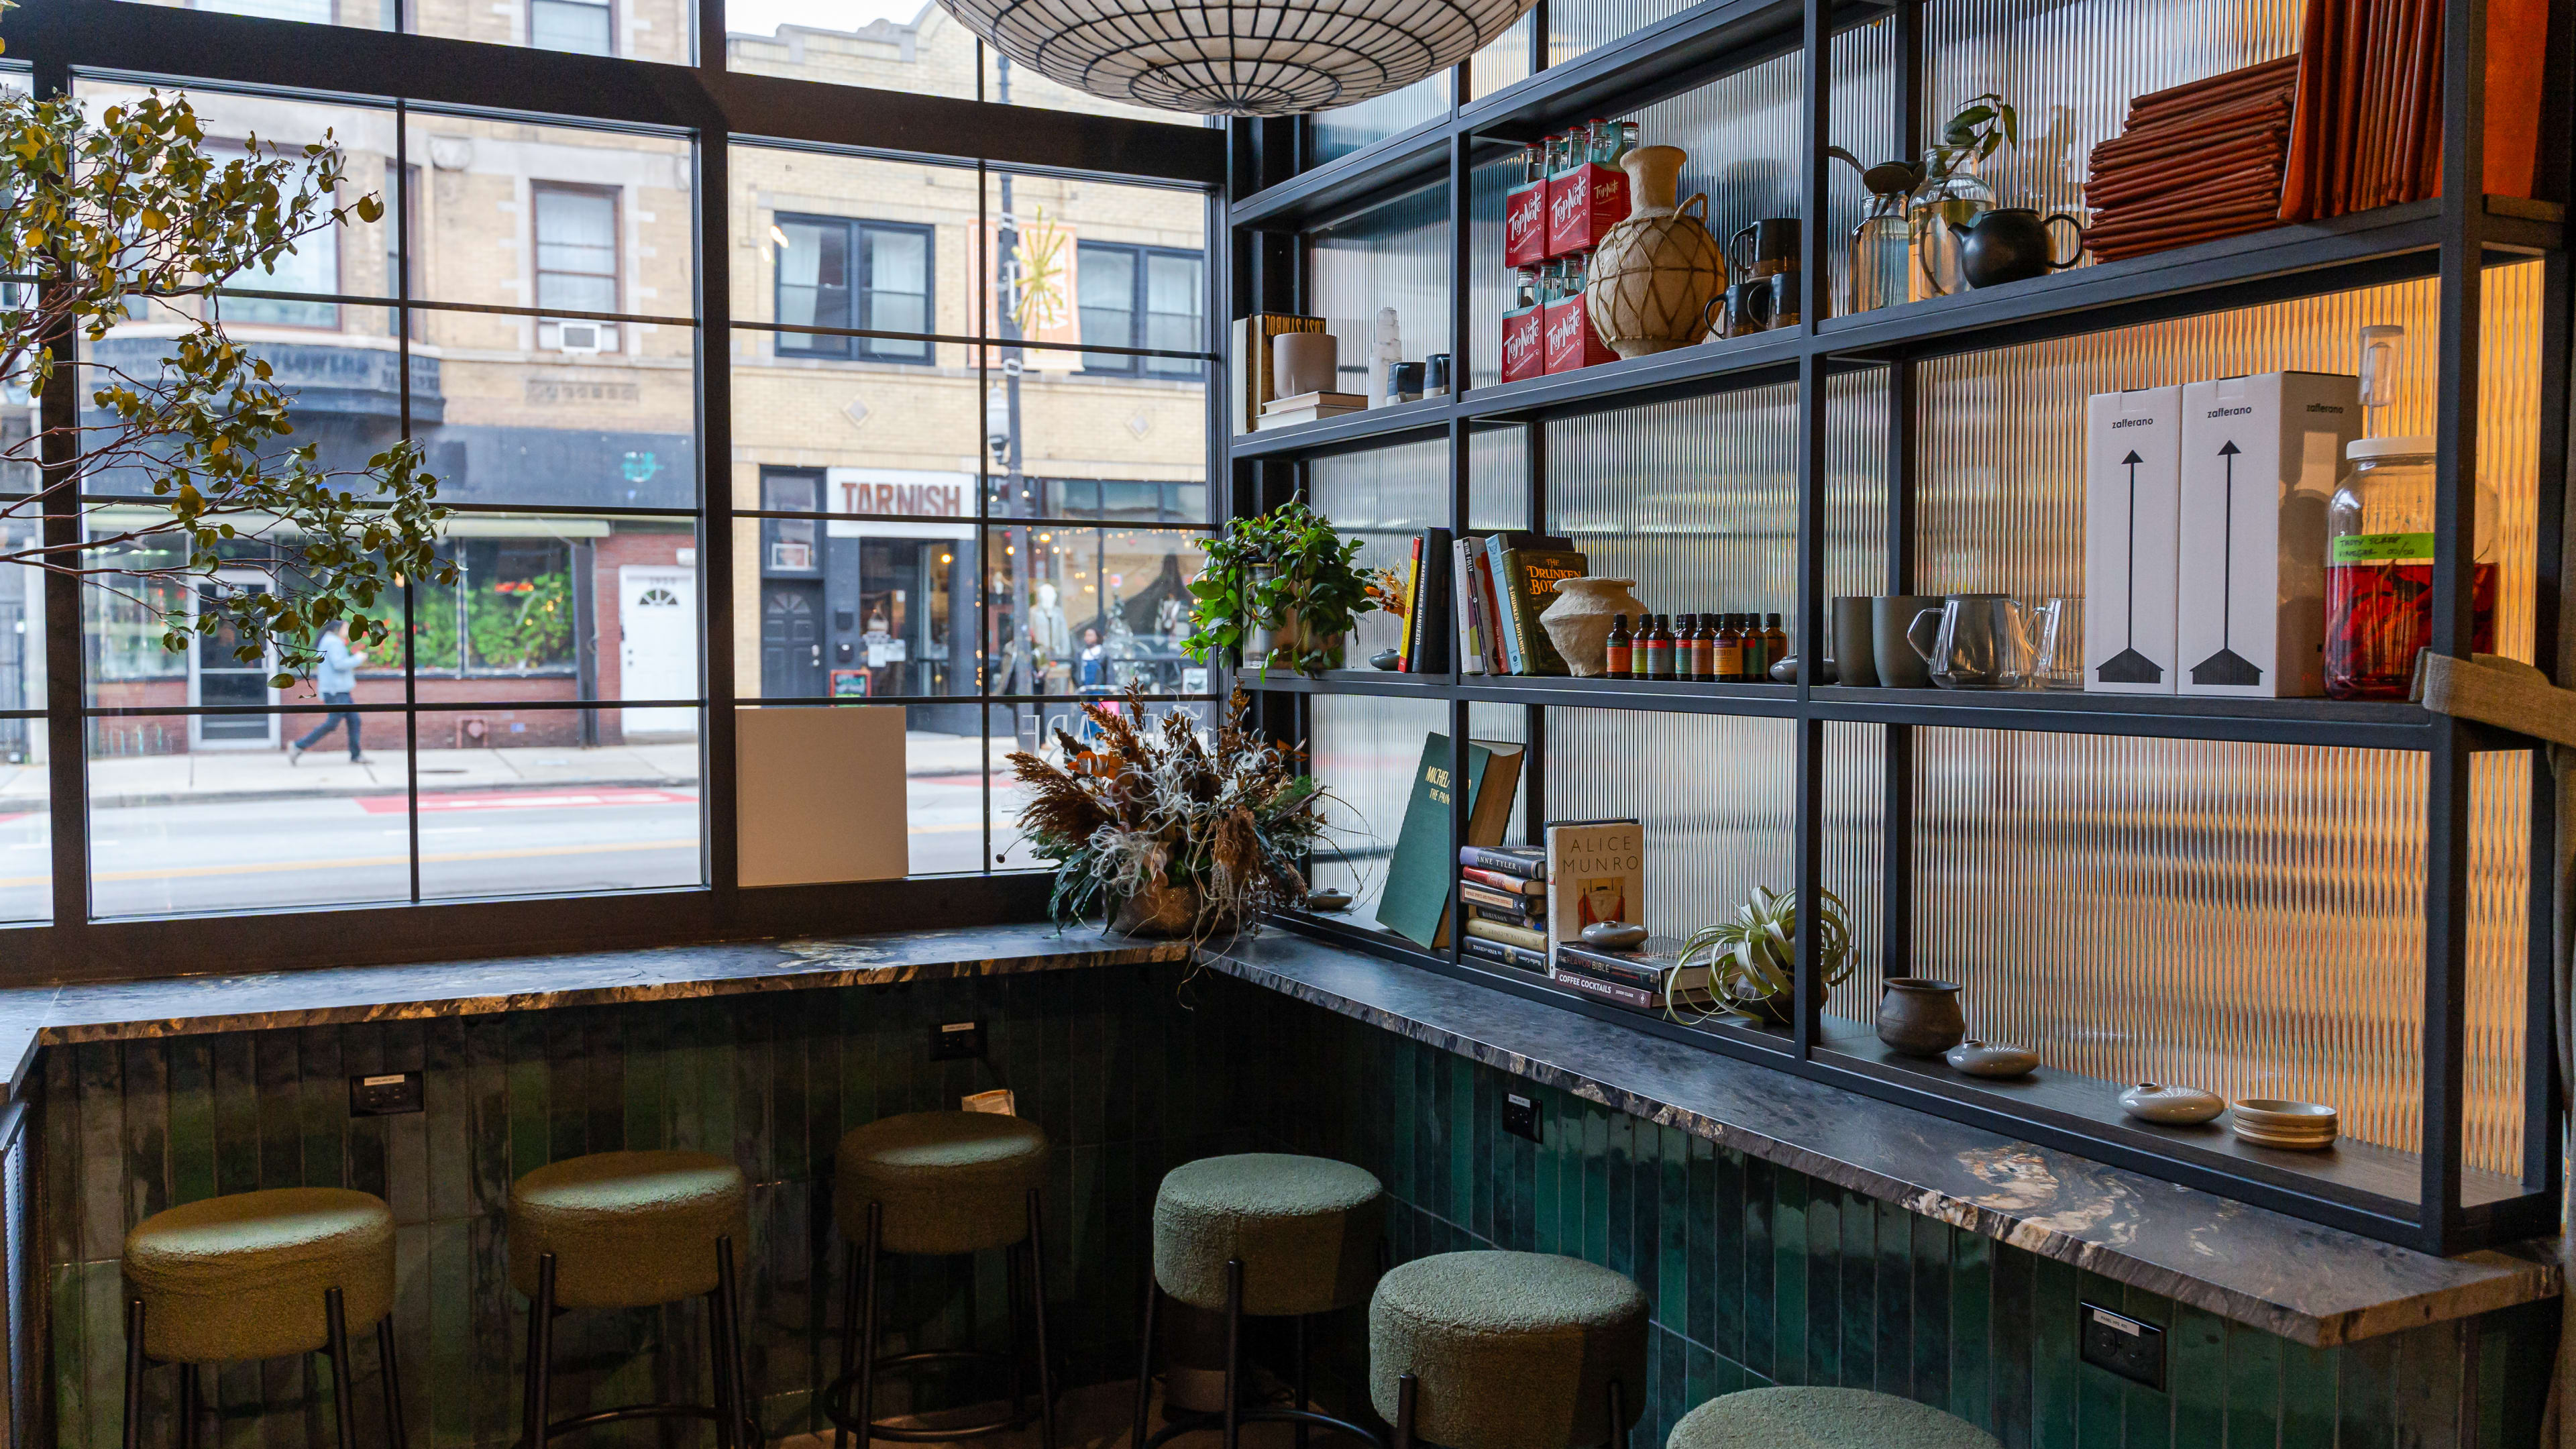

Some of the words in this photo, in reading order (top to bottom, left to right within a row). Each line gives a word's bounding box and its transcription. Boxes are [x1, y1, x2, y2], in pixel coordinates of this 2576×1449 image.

[2207, 406, 2252, 419] zafferano
[2306, 402, 2344, 414] zafferano
[2112, 417, 2153, 429] zafferano
[841, 482, 961, 517] TARNISH
[1466, 556, 1474, 572] FOLLY
[1546, 558, 1559, 568] THE
[1526, 565, 1581, 579] DRUNKEN
[1415, 609, 1423, 645] MANIFESTO
[1510, 591, 1519, 621] DRUNKEN
[1515, 623, 1525, 655] BOTANIST
[1430, 788, 1439, 800] THE
[1570, 837, 1631, 853] ALICE
[1476, 856, 1493, 865] ANNE
[1495, 859, 1517, 870] TYLER
[1563, 856, 1638, 873] MUNRO
[1482, 912, 1507, 922] ROBINSON
[1566, 956, 1591, 969] FLAVOR
[1592, 961, 1610, 973] BIBLE
[1559, 974, 1580, 986] COFFEE
[1580, 980, 1612, 994] COCKTAILS
